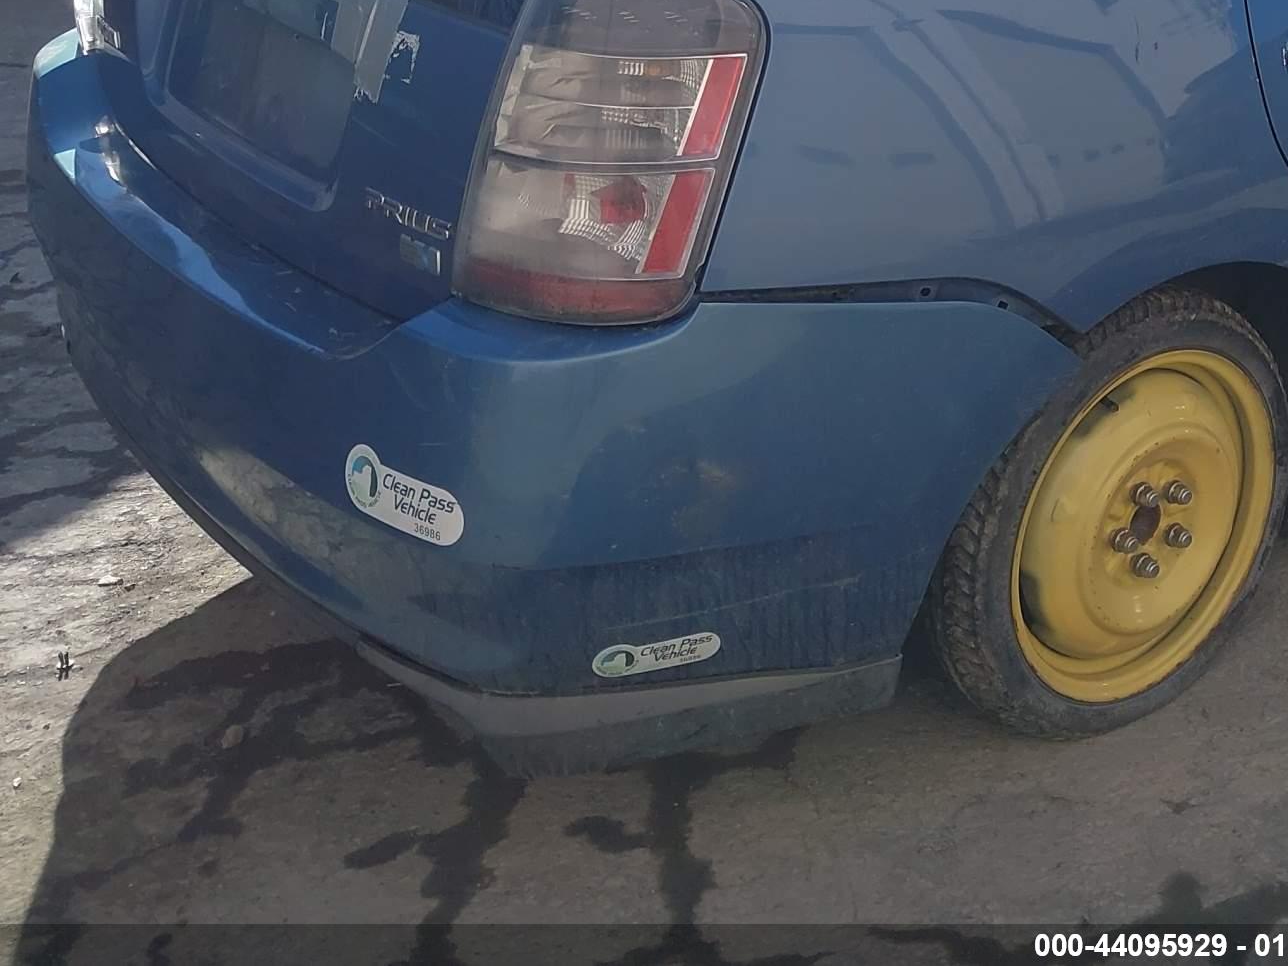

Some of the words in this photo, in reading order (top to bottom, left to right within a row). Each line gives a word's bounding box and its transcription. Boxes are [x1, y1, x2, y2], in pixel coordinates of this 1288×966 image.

[365, 186, 452, 241] PRIUS
[382, 473, 416, 500] Clean
[418, 487, 457, 514] Pass
[394, 494, 437, 525] Vehicle
[414, 522, 441, 541] 36986
[640, 643, 677, 657] Clean
[679, 635, 713, 650] Pass
[654, 646, 698, 662] Vehicle
